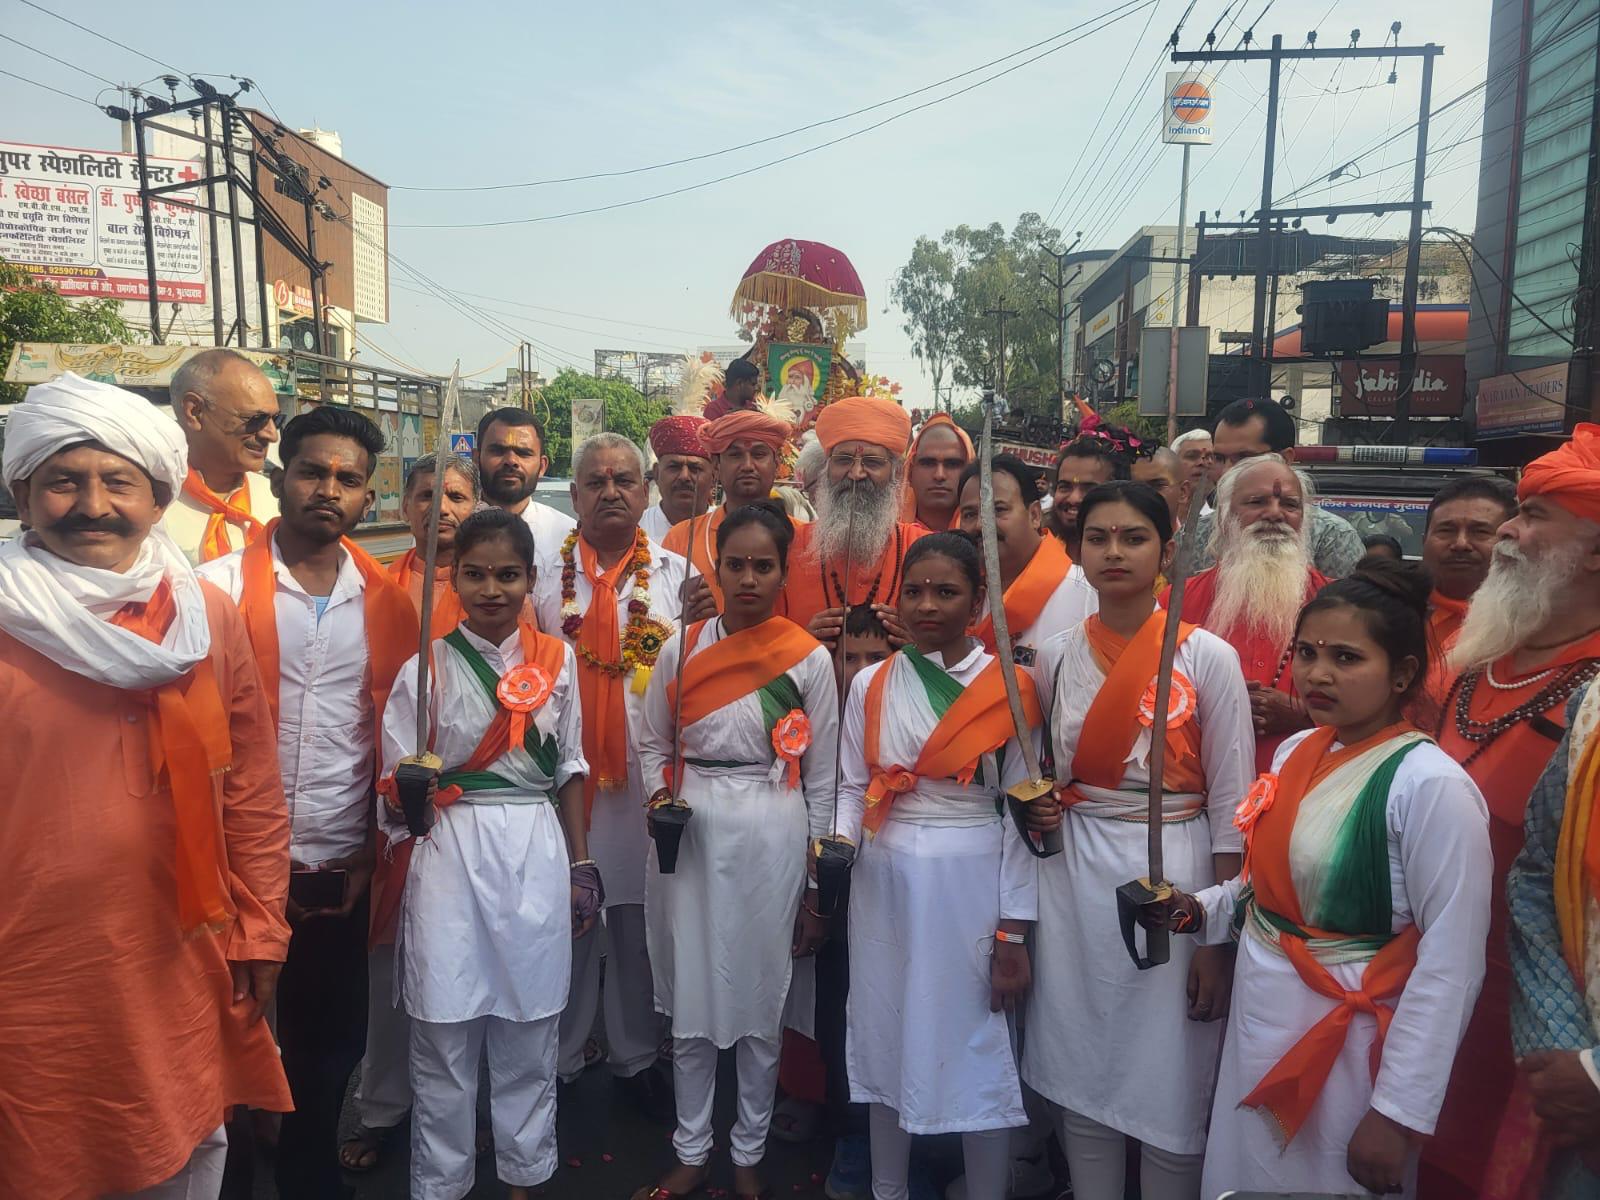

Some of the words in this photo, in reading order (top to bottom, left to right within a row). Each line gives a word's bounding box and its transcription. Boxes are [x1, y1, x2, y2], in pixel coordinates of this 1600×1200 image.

[1168, 126, 1211, 135] IndianOil
[38, 150, 123, 179] स्पेशलिटी
[55, 184, 90, 205] बंसल
[100, 188, 117, 207] डॉ.
[106, 224, 128, 234] बाल
[49, 266, 98, 277] 9259071497
